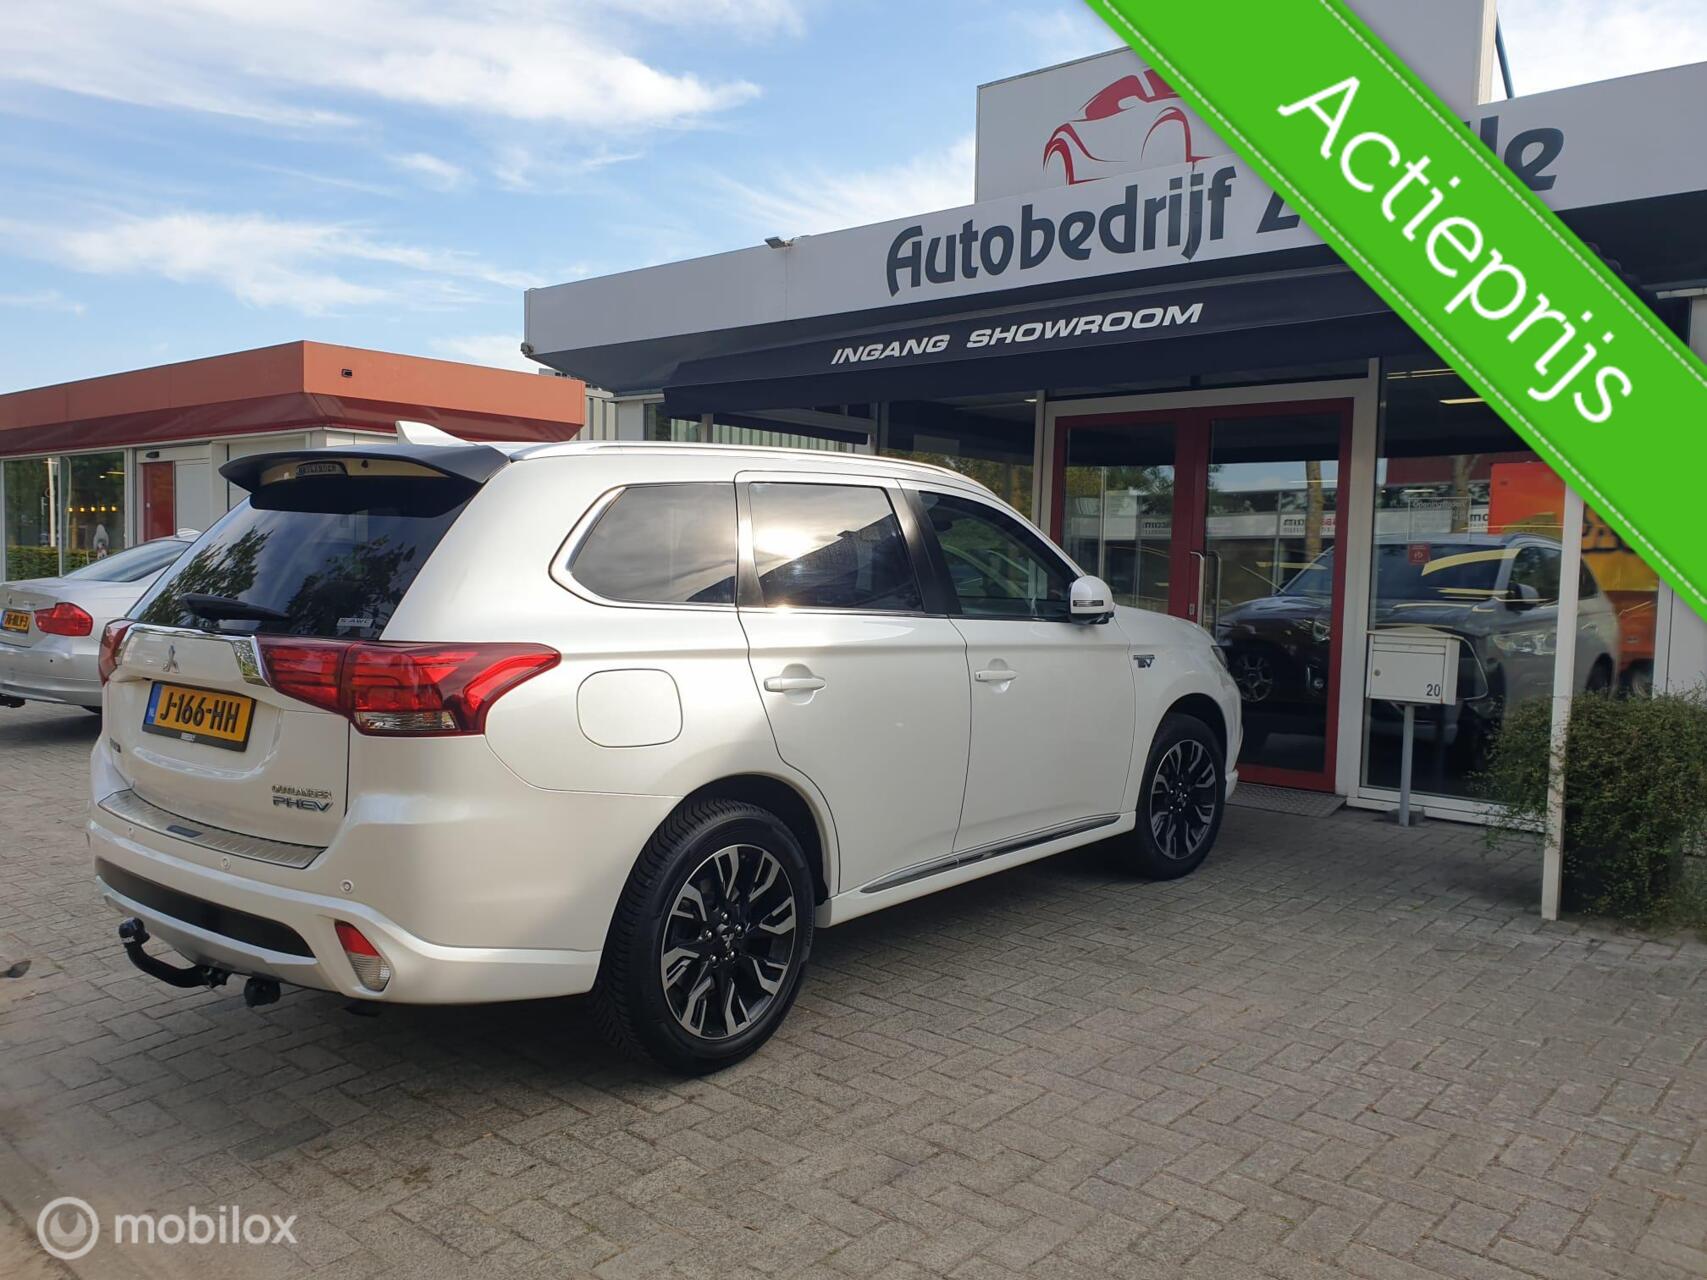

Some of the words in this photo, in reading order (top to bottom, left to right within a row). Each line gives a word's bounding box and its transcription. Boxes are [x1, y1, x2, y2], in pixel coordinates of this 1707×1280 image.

[885, 165, 1238, 297] Autobedrijf
[830, 334, 951, 366] INGANG
[966, 302, 1204, 349] SHOWROOM
[1426, 683, 1441, 697] 20
[159, 691, 241, 734] J-166-HH
[272, 795, 334, 813] PHEV
